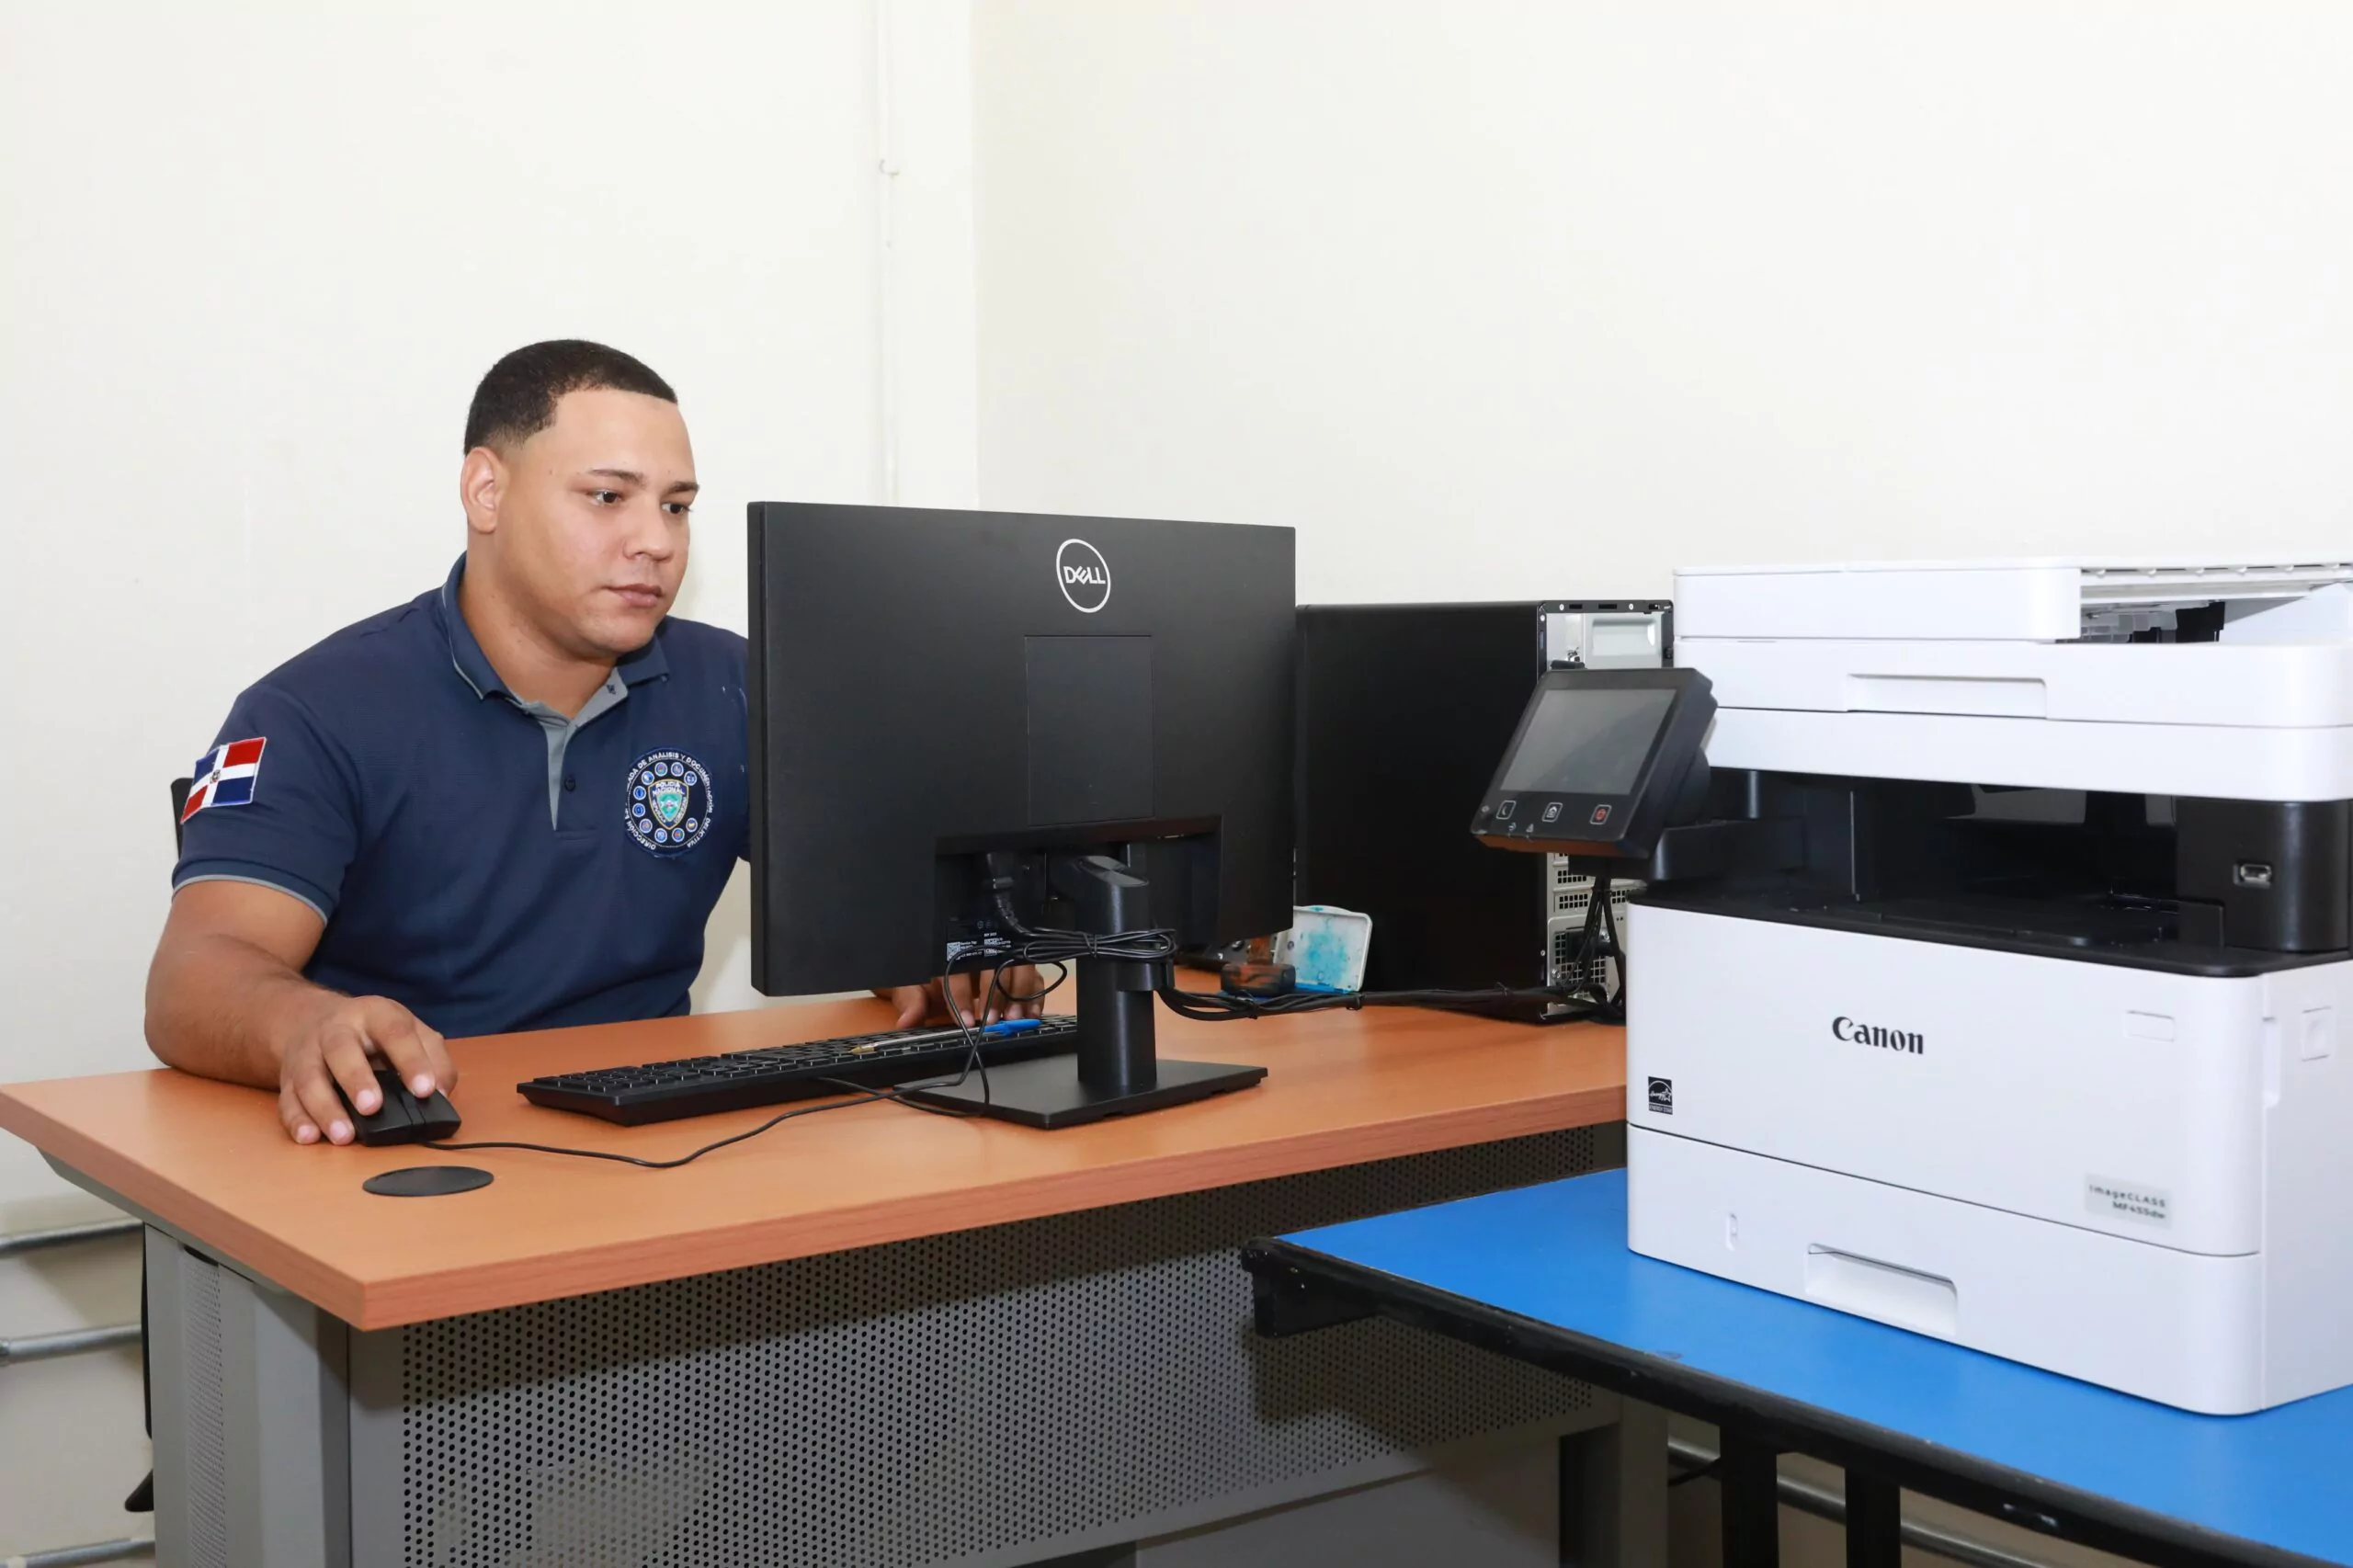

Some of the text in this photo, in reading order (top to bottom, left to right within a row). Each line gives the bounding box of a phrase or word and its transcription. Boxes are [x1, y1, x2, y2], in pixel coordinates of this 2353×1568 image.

[1063, 565, 1107, 585] DELL
[637, 759, 647, 769] DE
[1832, 1016, 1924, 1055] Canon
